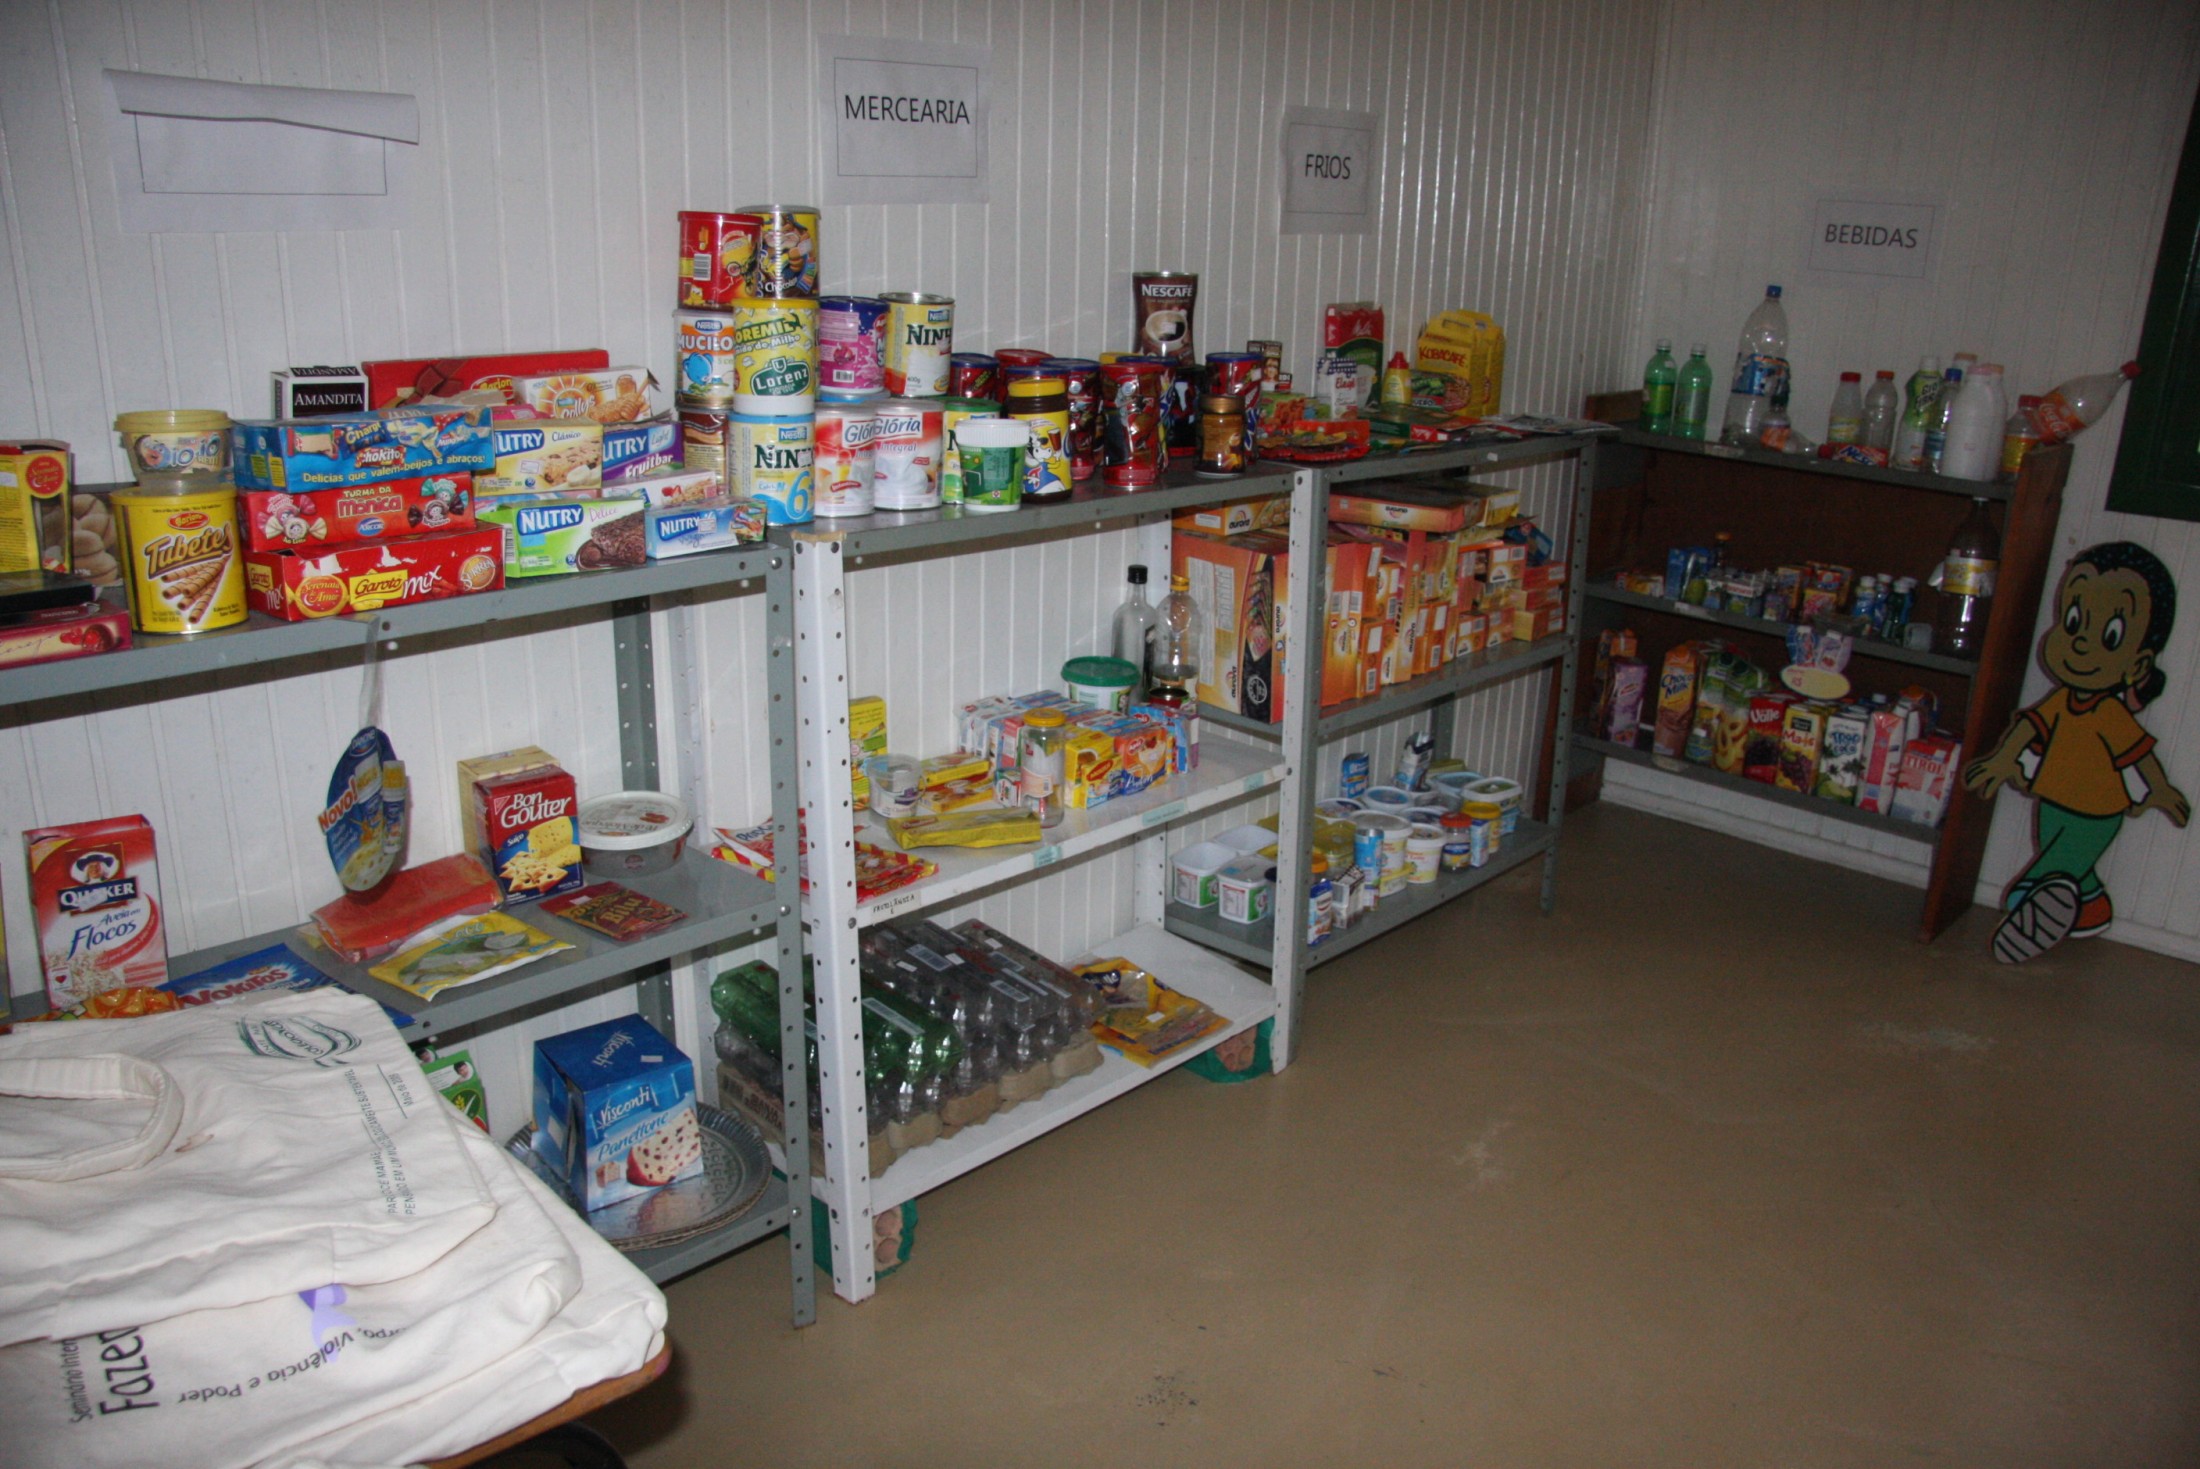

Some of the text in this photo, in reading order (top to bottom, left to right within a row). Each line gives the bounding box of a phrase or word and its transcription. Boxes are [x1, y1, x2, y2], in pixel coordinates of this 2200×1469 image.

[844, 94, 970, 125] MERCEARIA
[1305, 153, 1351, 180] FRIOS
[1825, 223, 1919, 249] BEBIDAS
[1142, 283, 1193, 298] NESCAFÉ
[678, 333, 733, 351] MUCILO
[906, 323, 952, 346] NIN
[293, 367, 359, 377] AMANDITA
[756, 367, 808, 390] Lorenz
[294, 392, 364, 407] AMANDITA
[551, 430, 581, 442] Clássico
[844, 423, 876, 444] Glór
[874, 417, 921, 436] Glória
[603, 428, 670, 462] UTRY Light
[754, 444, 814, 470] NIN
[348, 471, 367, 482] que
[436, 457, 443, 465] e
[625, 453, 674, 478] Fruitbar
[344, 486, 392, 499] TURMA DA
[785, 469, 811, 521] 6
[520, 507, 583, 535] NUTRY
[660, 515, 701, 537] NUTRY
[1229, 518, 1250, 529] aurora
[145, 523, 235, 580] Tubetes
[355, 577, 405, 597] Garoto
[1750, 708, 1780, 723] Valle
[513, 791, 543, 809] Bon
[59, 882, 136, 908] QUKER
[97, 909, 130, 928] Aveia
[66, 919, 137, 961] Flocos
[593, 1029, 635, 1068] Visconti
[598, 1085, 651, 1126] Visconti
[598, 1111, 669, 1161] Panettone
[177, 1327, 408, 1405] orpo, Violência e Poder
[62, 1369, 93, 1424] Seminário
